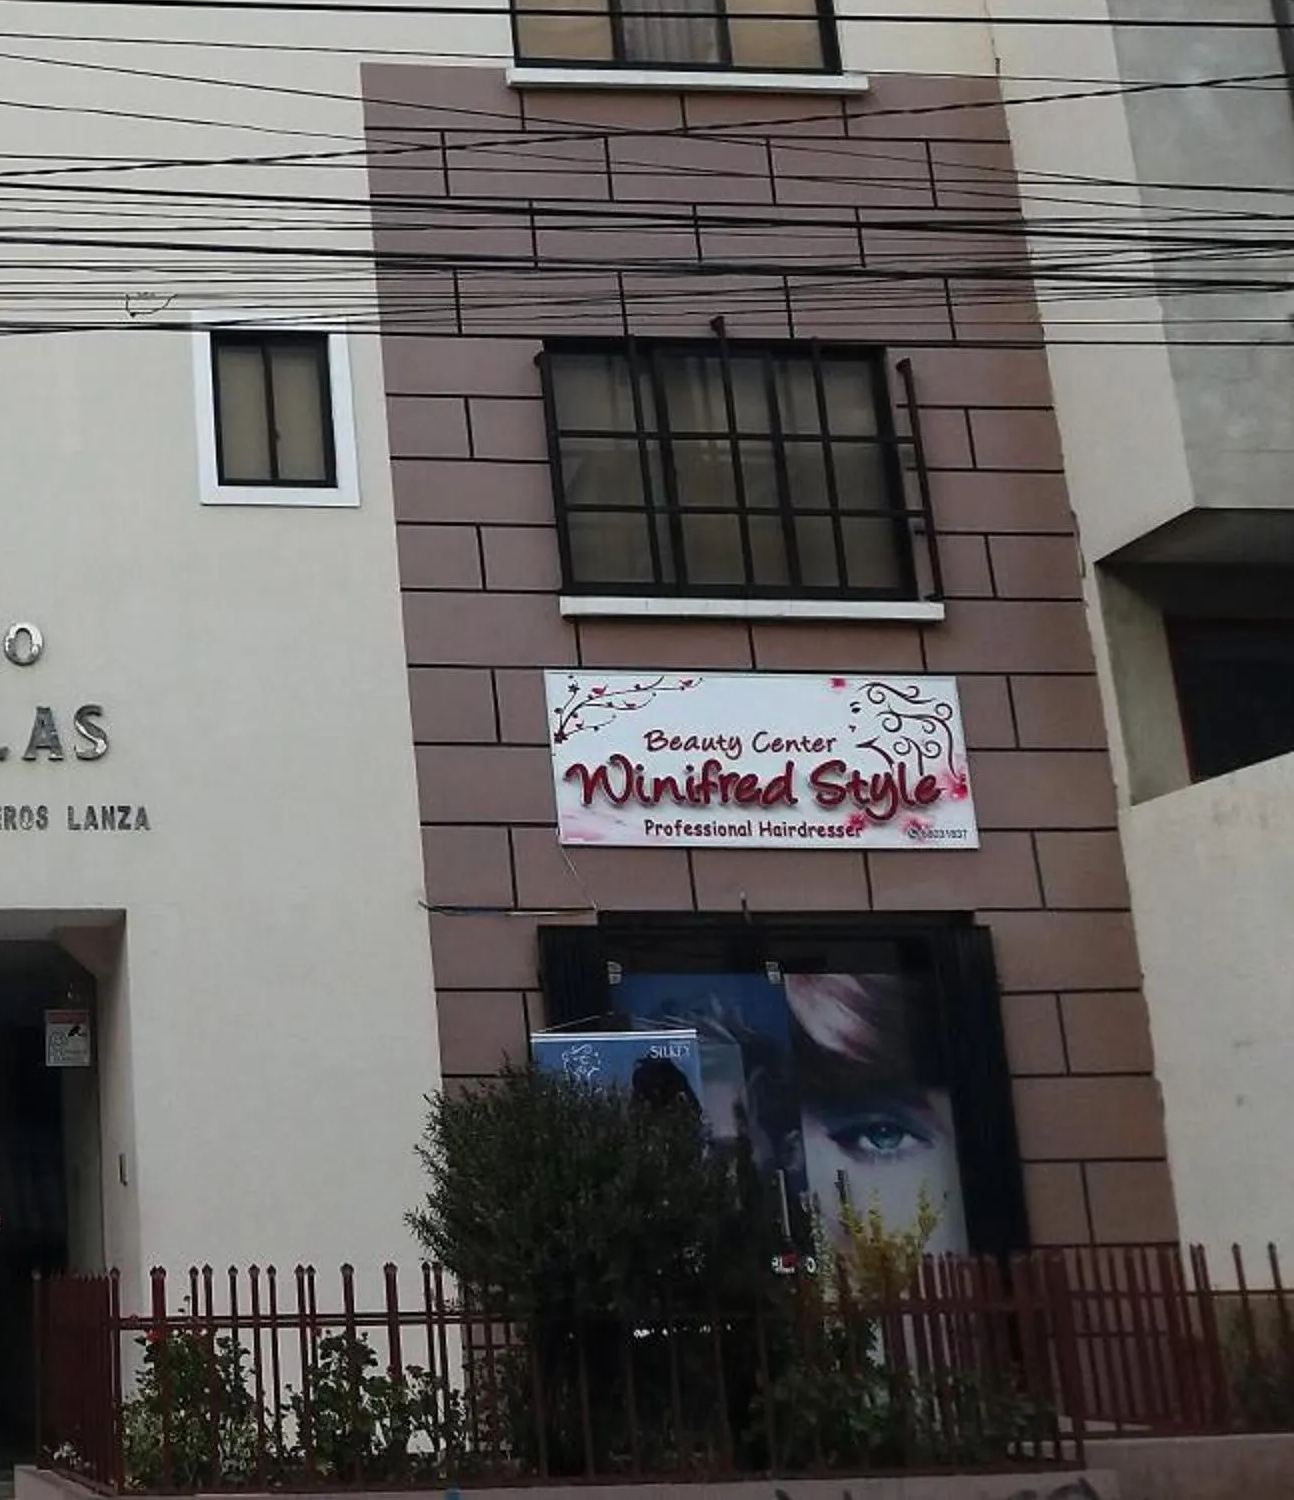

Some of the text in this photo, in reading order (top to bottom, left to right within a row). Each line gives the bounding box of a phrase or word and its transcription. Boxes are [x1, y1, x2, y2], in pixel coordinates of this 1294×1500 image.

[643, 729, 838, 760] Beauty Center
[564, 754, 946, 821] Winifred Style
[67, 804, 152, 831] LANZA
[644, 819, 864, 840] Professional Hairdresser
